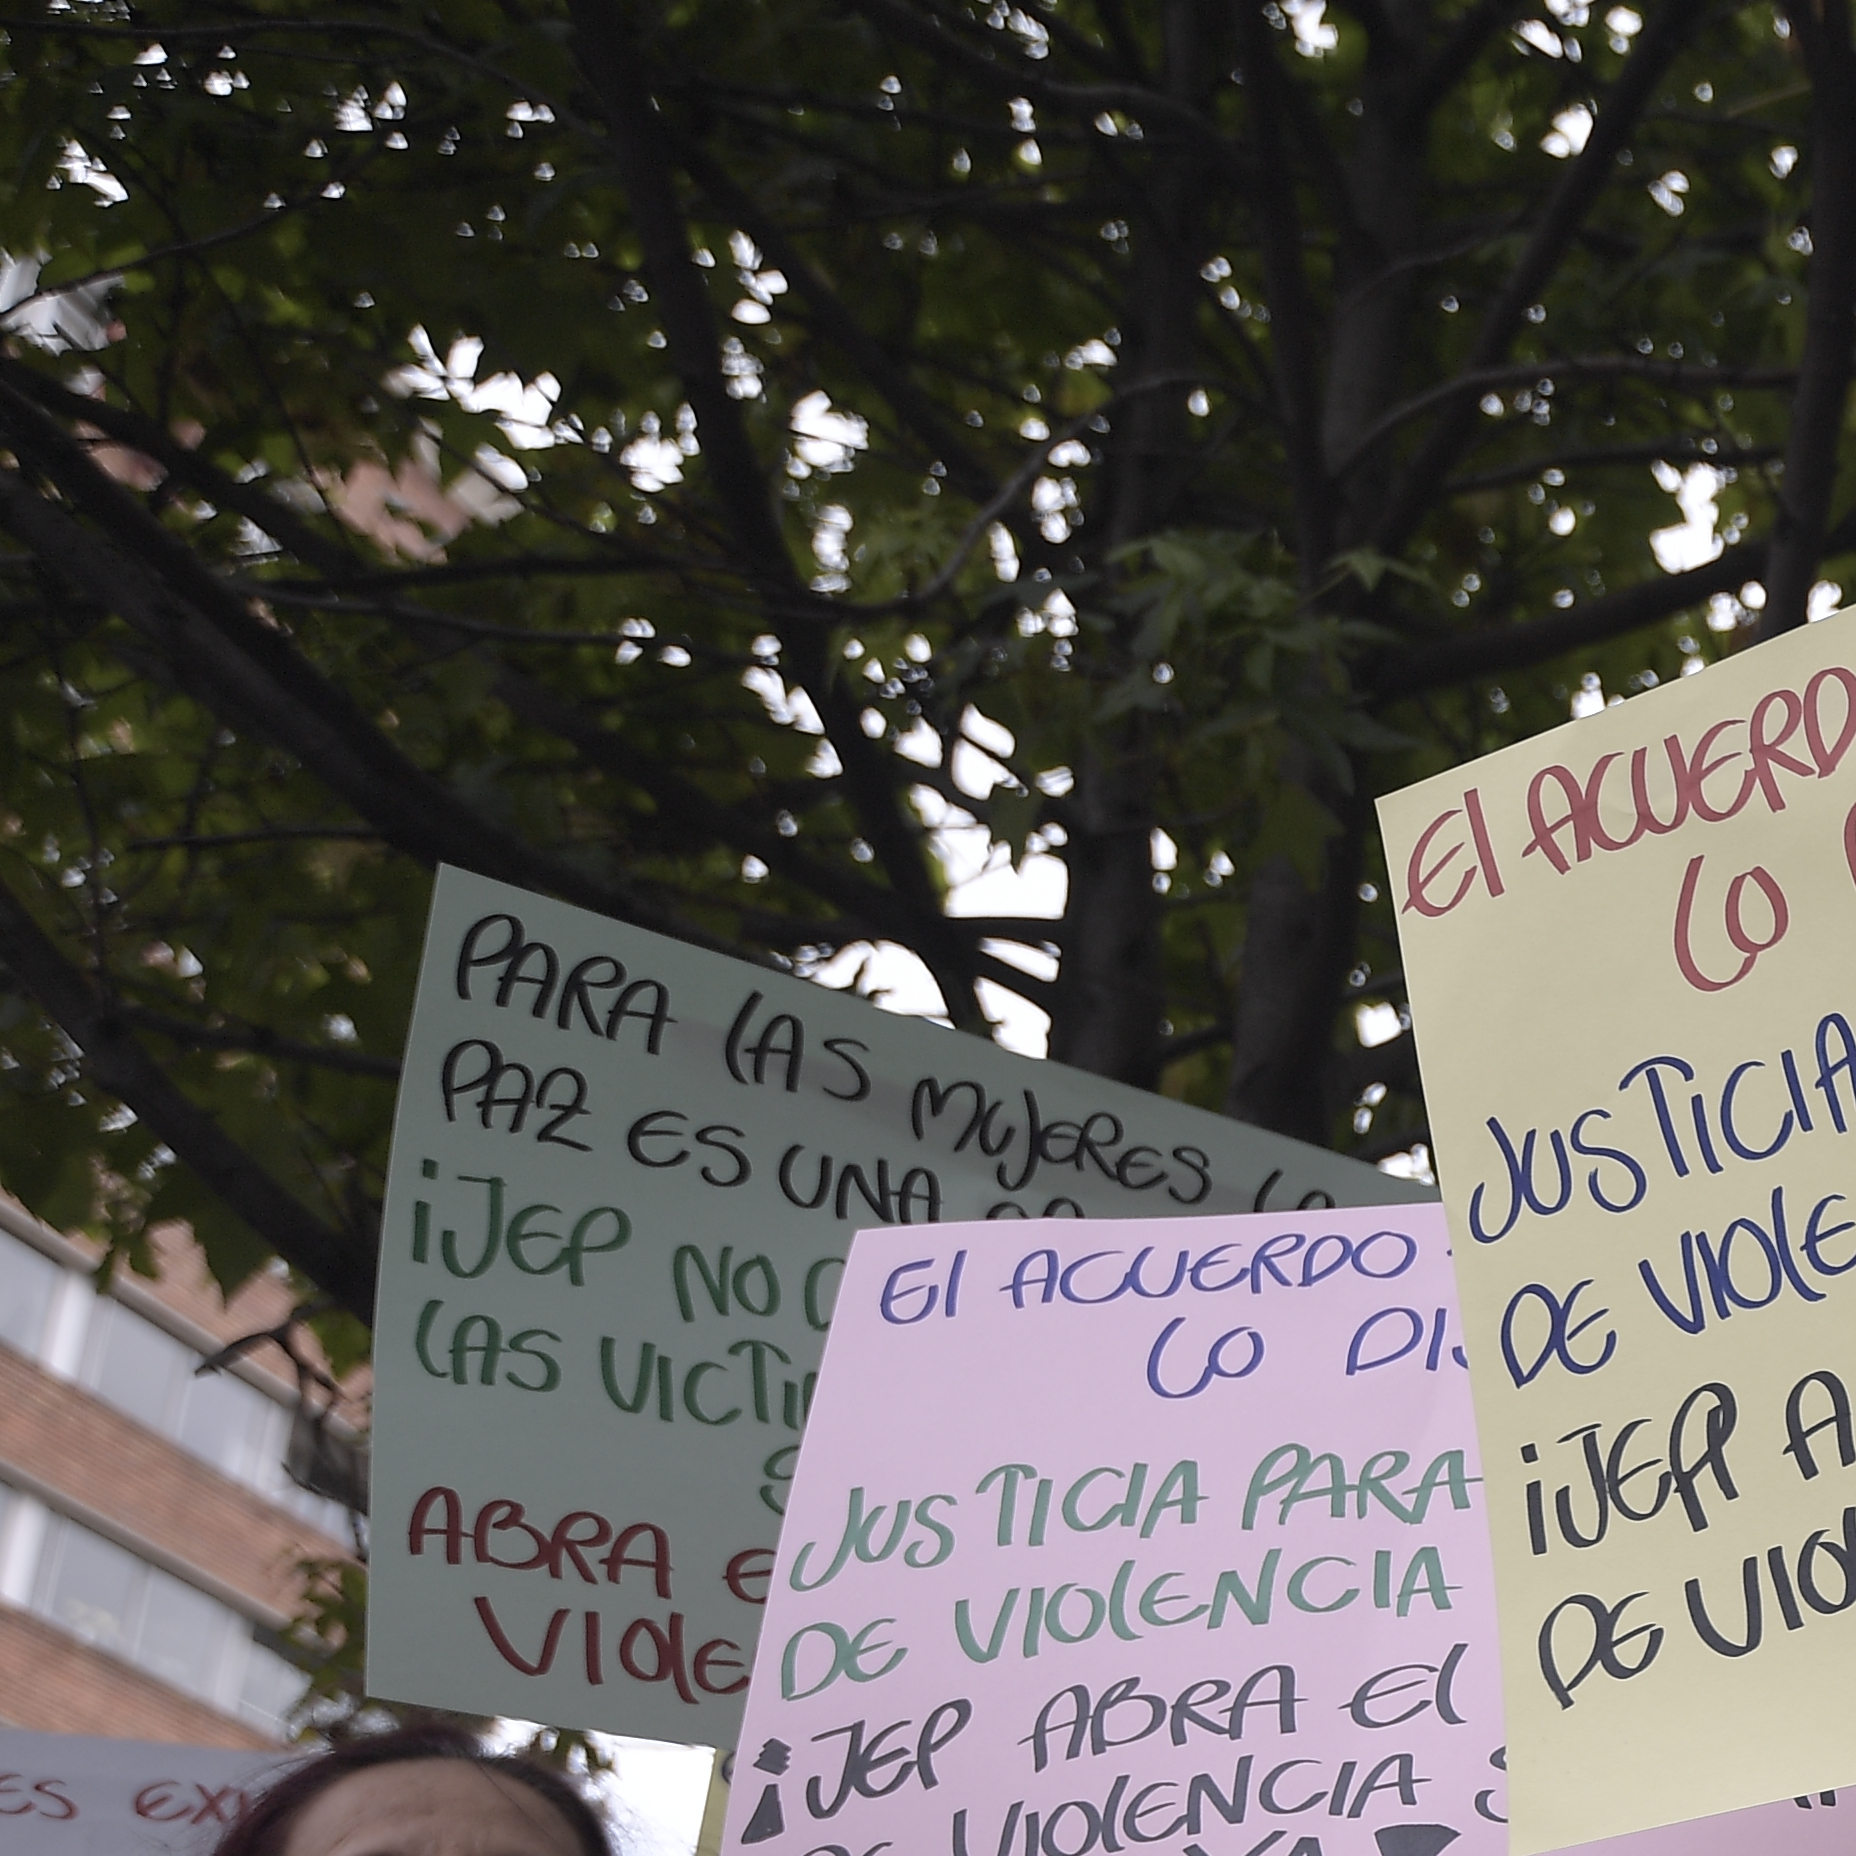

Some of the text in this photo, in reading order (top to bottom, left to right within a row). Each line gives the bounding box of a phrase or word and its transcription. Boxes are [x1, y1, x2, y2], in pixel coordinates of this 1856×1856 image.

[455, 913, 678, 1057] PARA
[911, 1075, 1212, 1206] MUJERES
[441, 1038, 945, 1224] PAZ ES UNA
[672, 1242, 780, 1322] NO
[999, 1231, 1418, 1309] ACUERDO
[1501, 1280, 1616, 1387] DE
[407, 1485, 673, 1598] ABRA
[789, 1458, 1209, 1593] JUSTICIA
[1241, 1442, 1483, 1529] PARA
[780, 1616, 907, 1700] DE
[1539, 1592, 1663, 1710] DE
[1018, 1664, 1308, 1772] ABRA
